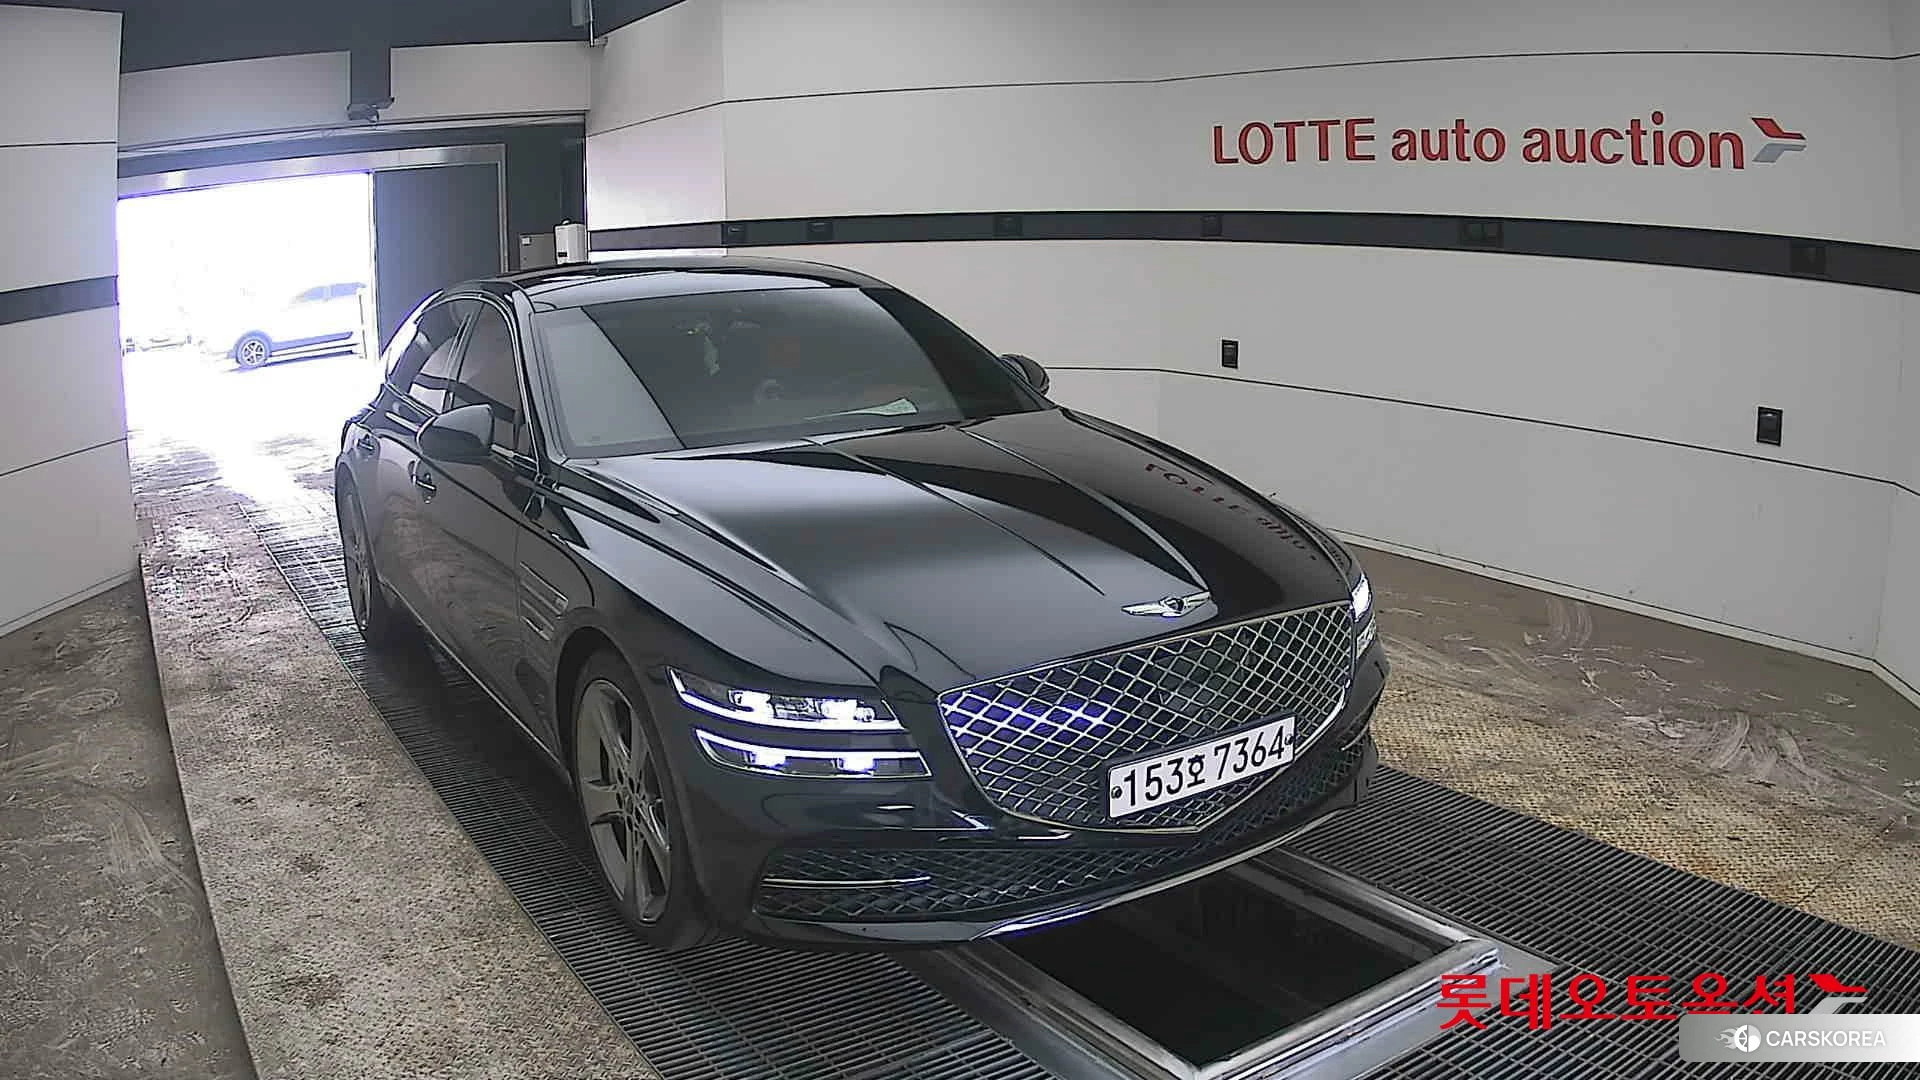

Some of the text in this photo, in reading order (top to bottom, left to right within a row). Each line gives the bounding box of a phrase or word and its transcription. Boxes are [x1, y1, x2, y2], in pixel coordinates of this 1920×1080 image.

[1213, 111, 1745, 169] LOTTE auto auction
[1123, 725, 1285, 807] 153호 7364
